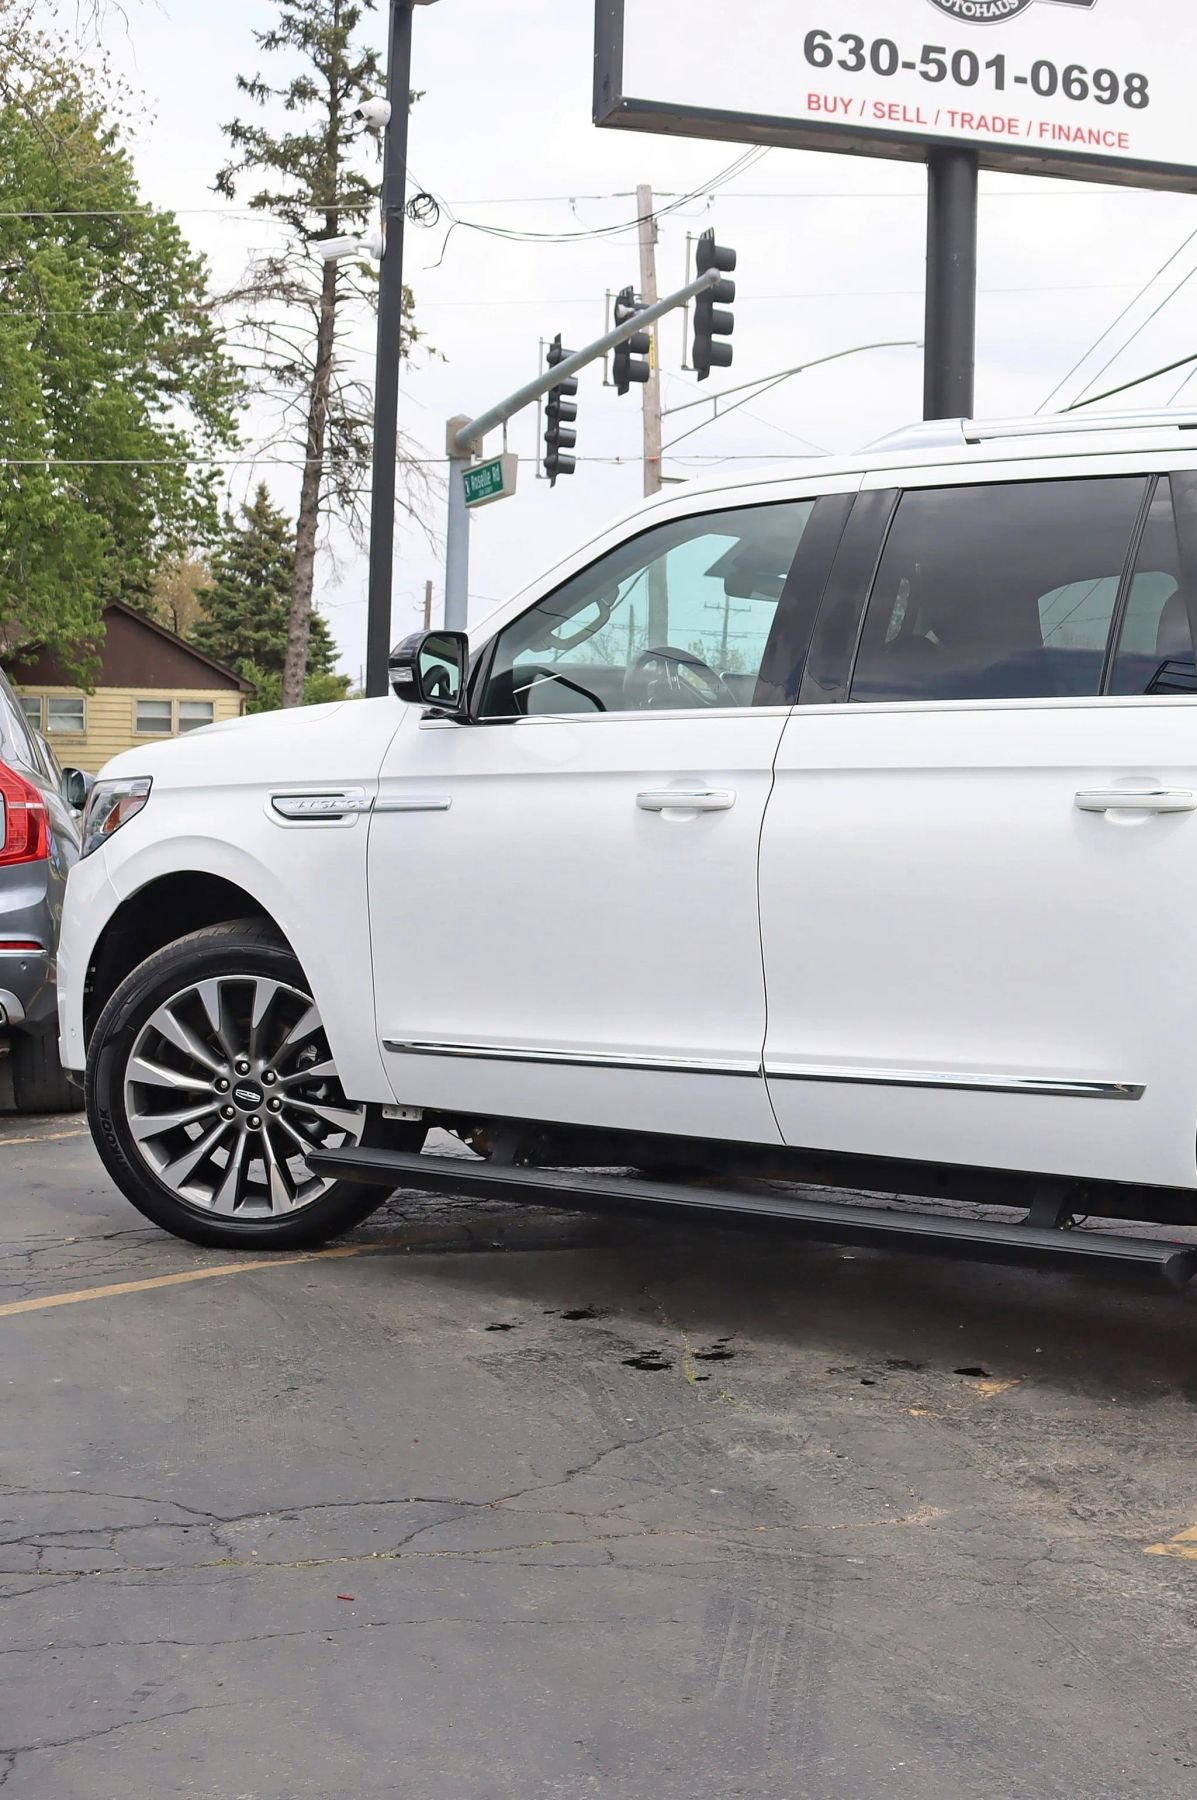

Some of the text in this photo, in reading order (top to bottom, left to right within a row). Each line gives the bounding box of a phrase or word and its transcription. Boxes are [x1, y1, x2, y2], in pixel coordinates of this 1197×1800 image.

[803, 29, 1150, 109] 630-501-0698
[807, 93, 853, 115] BUY
[872, 102, 927, 124] SELL
[946, 110, 1020, 136] TRADE
[1039, 121, 1130, 149] FINANCE
[491, 463, 500, 482] Rd
